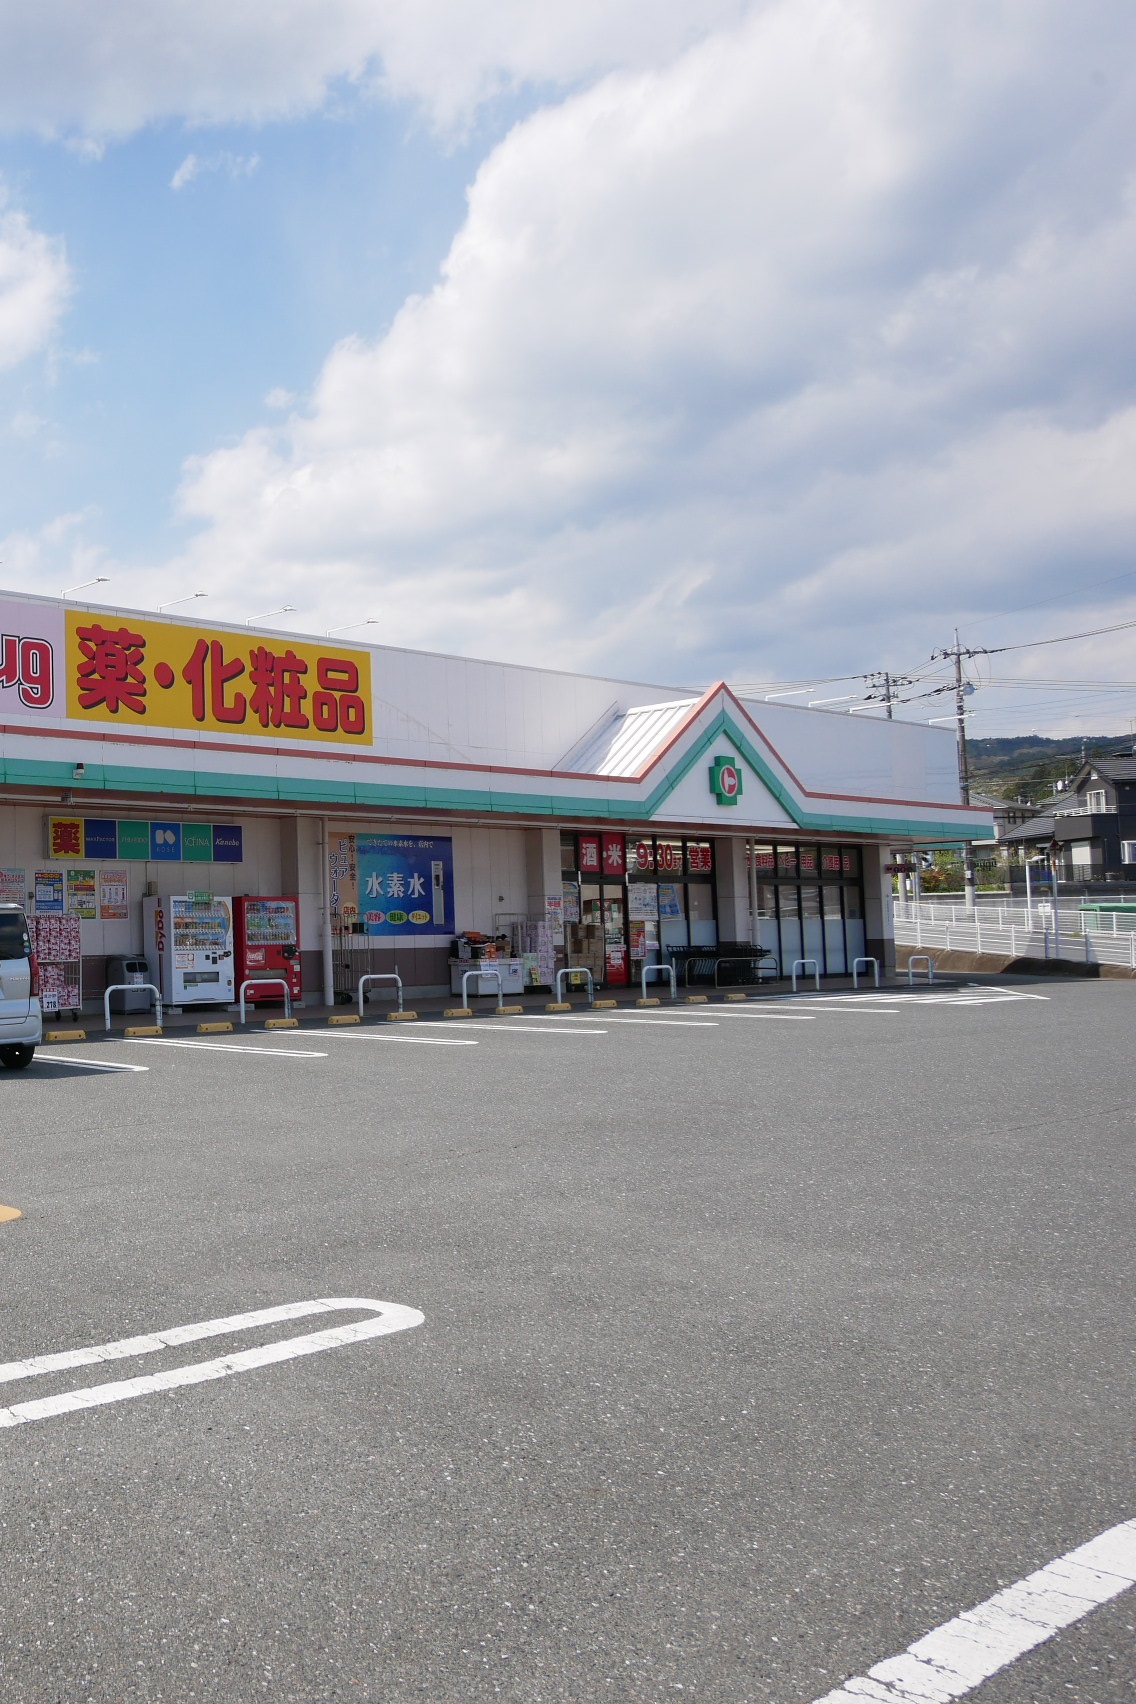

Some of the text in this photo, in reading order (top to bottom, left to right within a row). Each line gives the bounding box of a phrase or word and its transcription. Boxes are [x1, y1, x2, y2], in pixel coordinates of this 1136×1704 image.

[76, 624, 365, 735] 薬・化粧品
[52, 822, 80, 854] 薬
[215, 838, 239, 847] Kanebo
[339, 839, 349, 879] ピュア
[582, 843, 622, 867] 酒・米
[365, 872, 425, 898] 水素水
